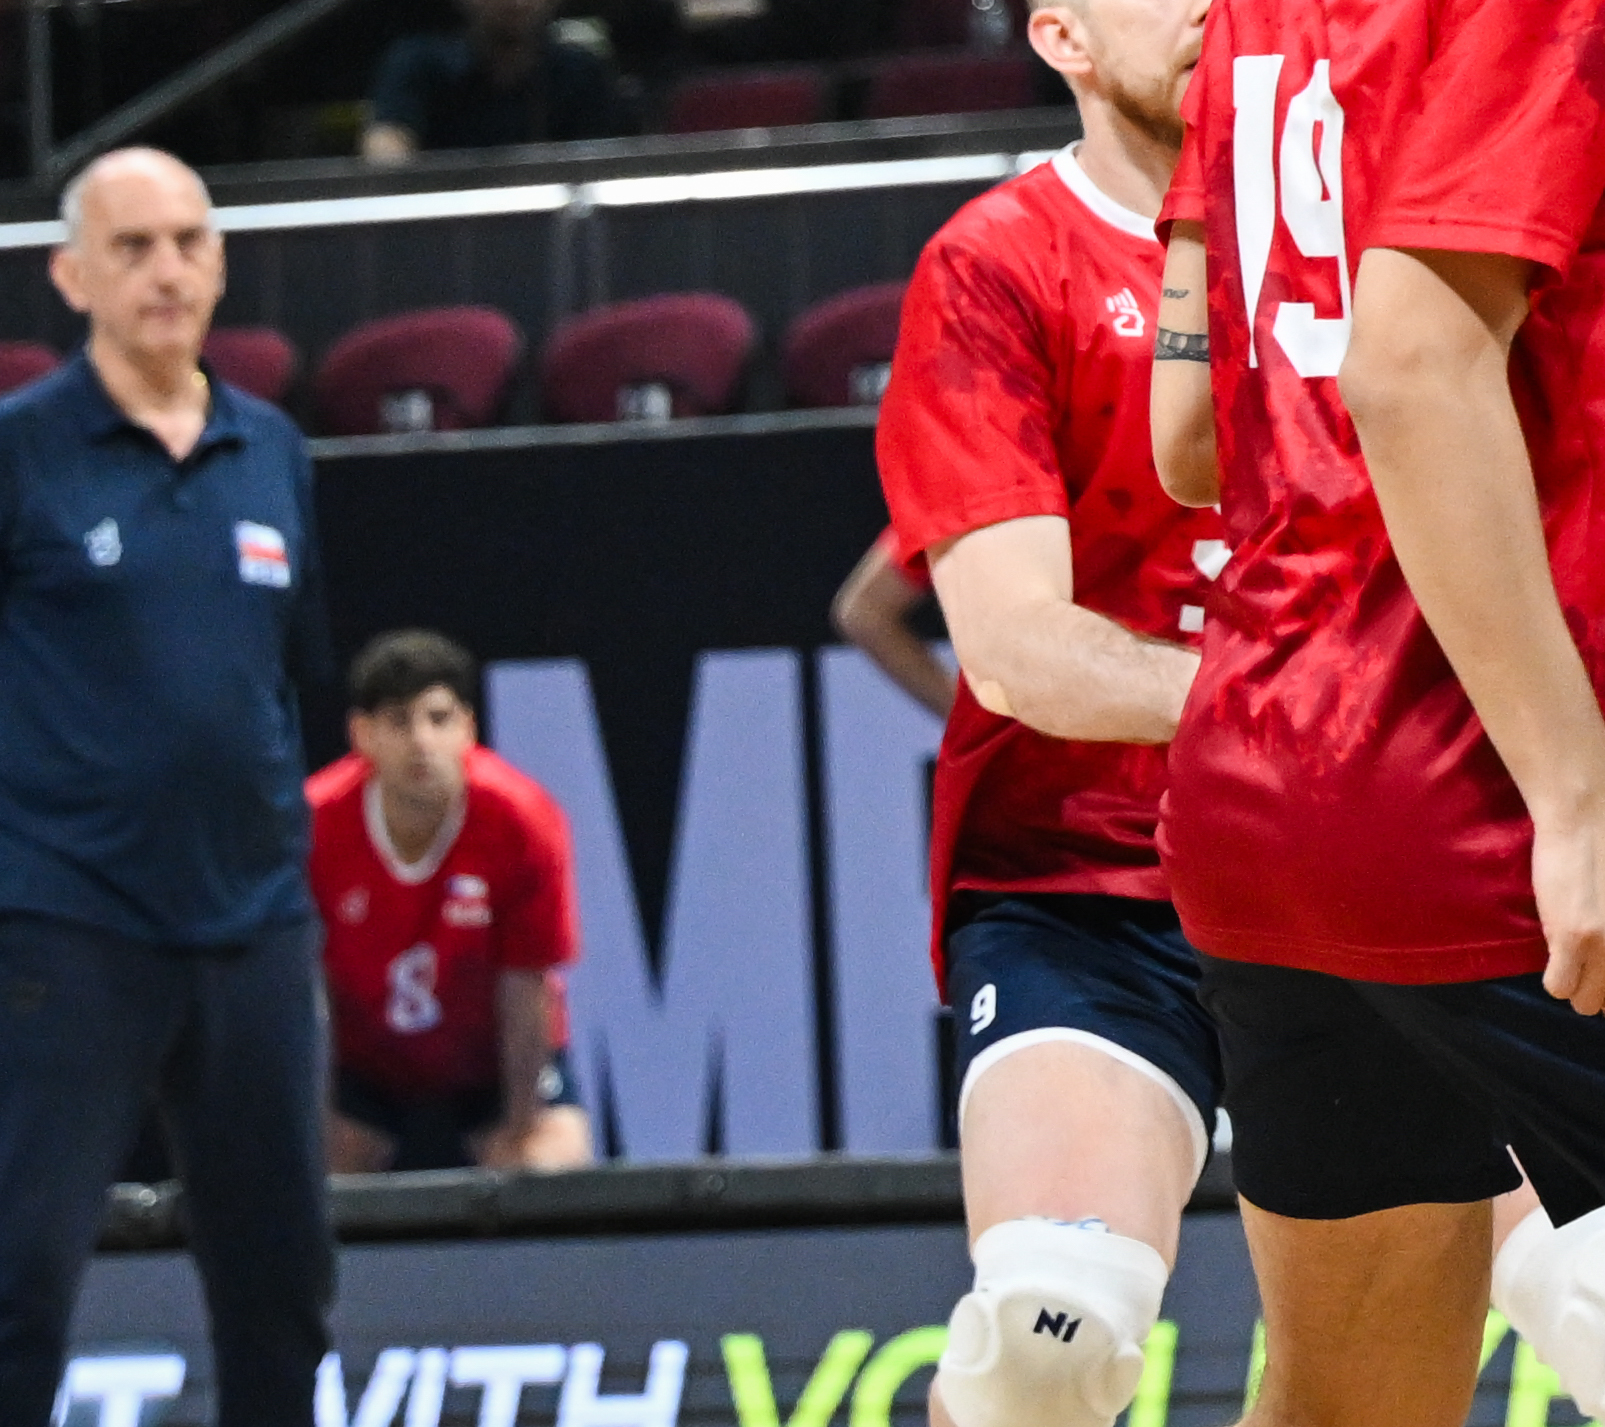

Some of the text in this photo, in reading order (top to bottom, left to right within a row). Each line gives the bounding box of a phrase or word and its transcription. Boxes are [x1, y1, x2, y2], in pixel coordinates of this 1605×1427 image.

[1233, 53, 1353, 379] 19
[386, 942, 444, 1033] 8
[970, 983, 997, 1036] 9
[314, 1339, 688, 1427] WITH
